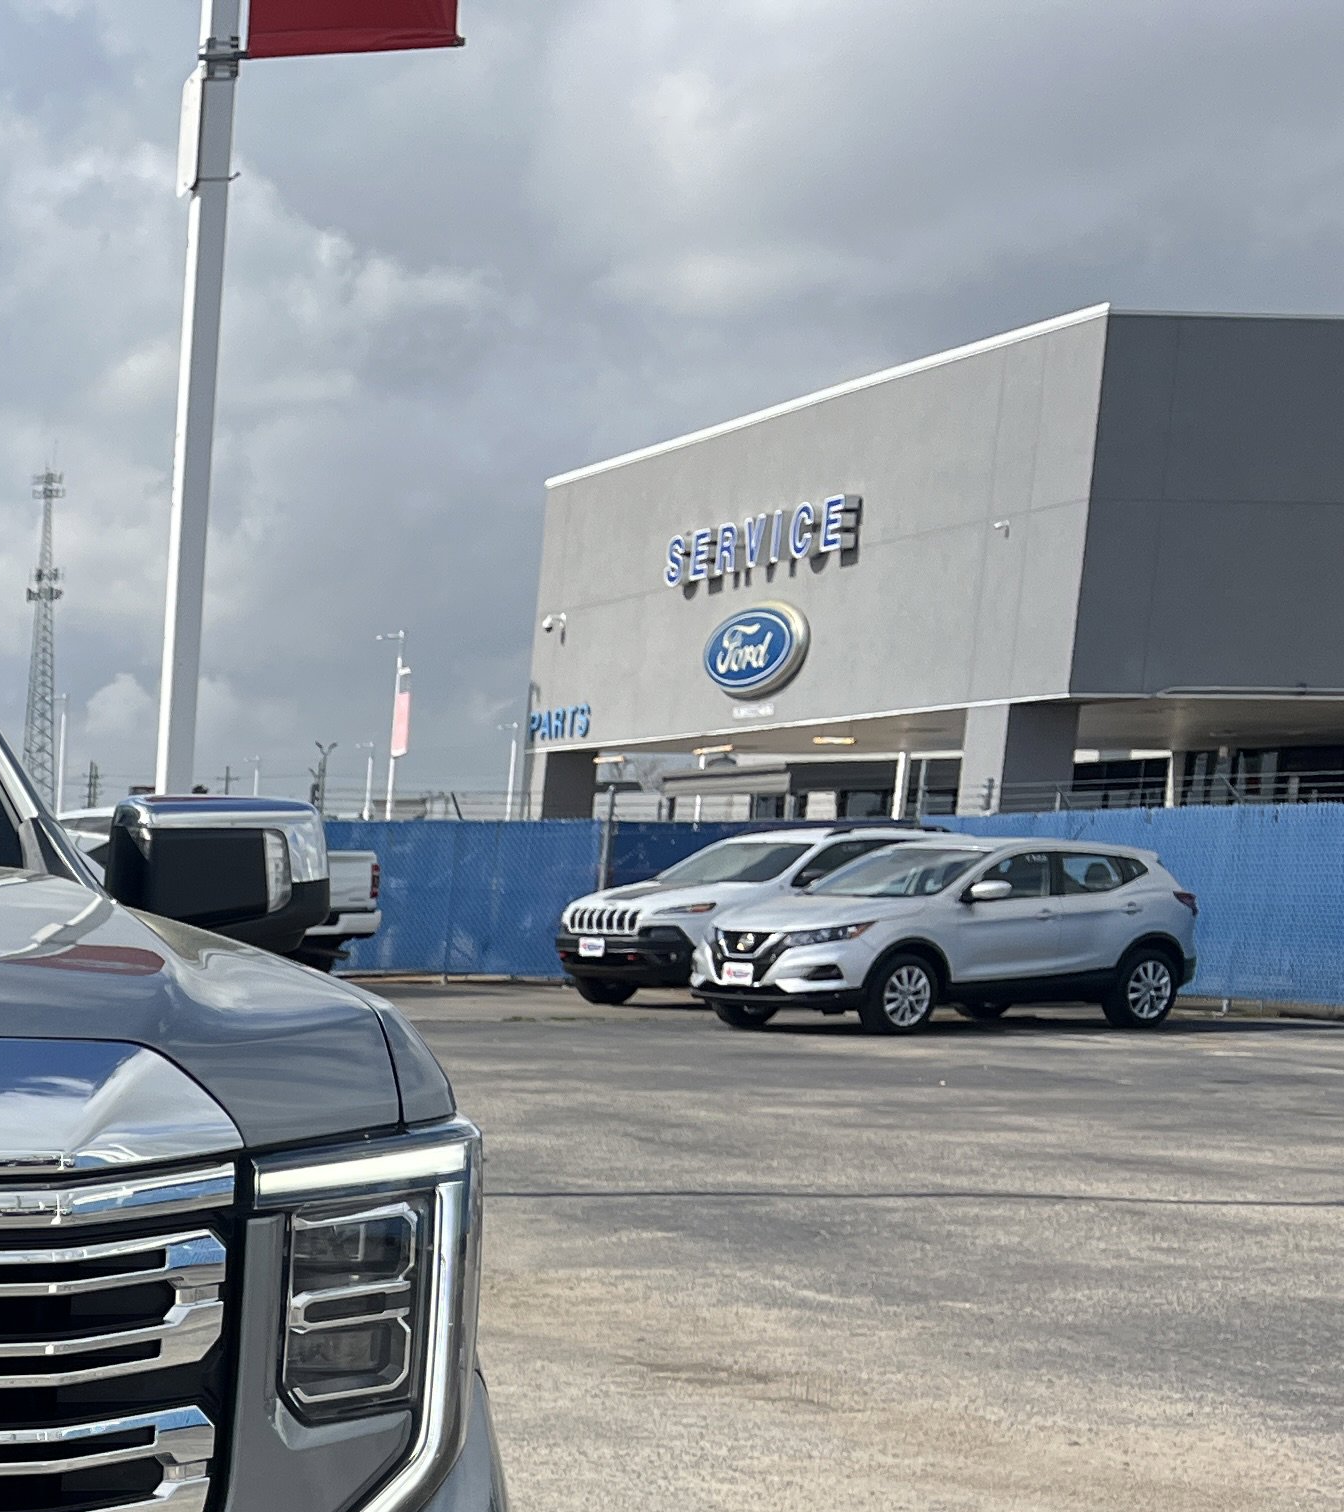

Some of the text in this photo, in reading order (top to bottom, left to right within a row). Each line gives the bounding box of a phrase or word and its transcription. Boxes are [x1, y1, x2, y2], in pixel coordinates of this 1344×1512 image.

[664, 494, 846, 588] SERVICE
[716, 622, 774, 675] Ford
[529, 703, 591, 741] PARTS
